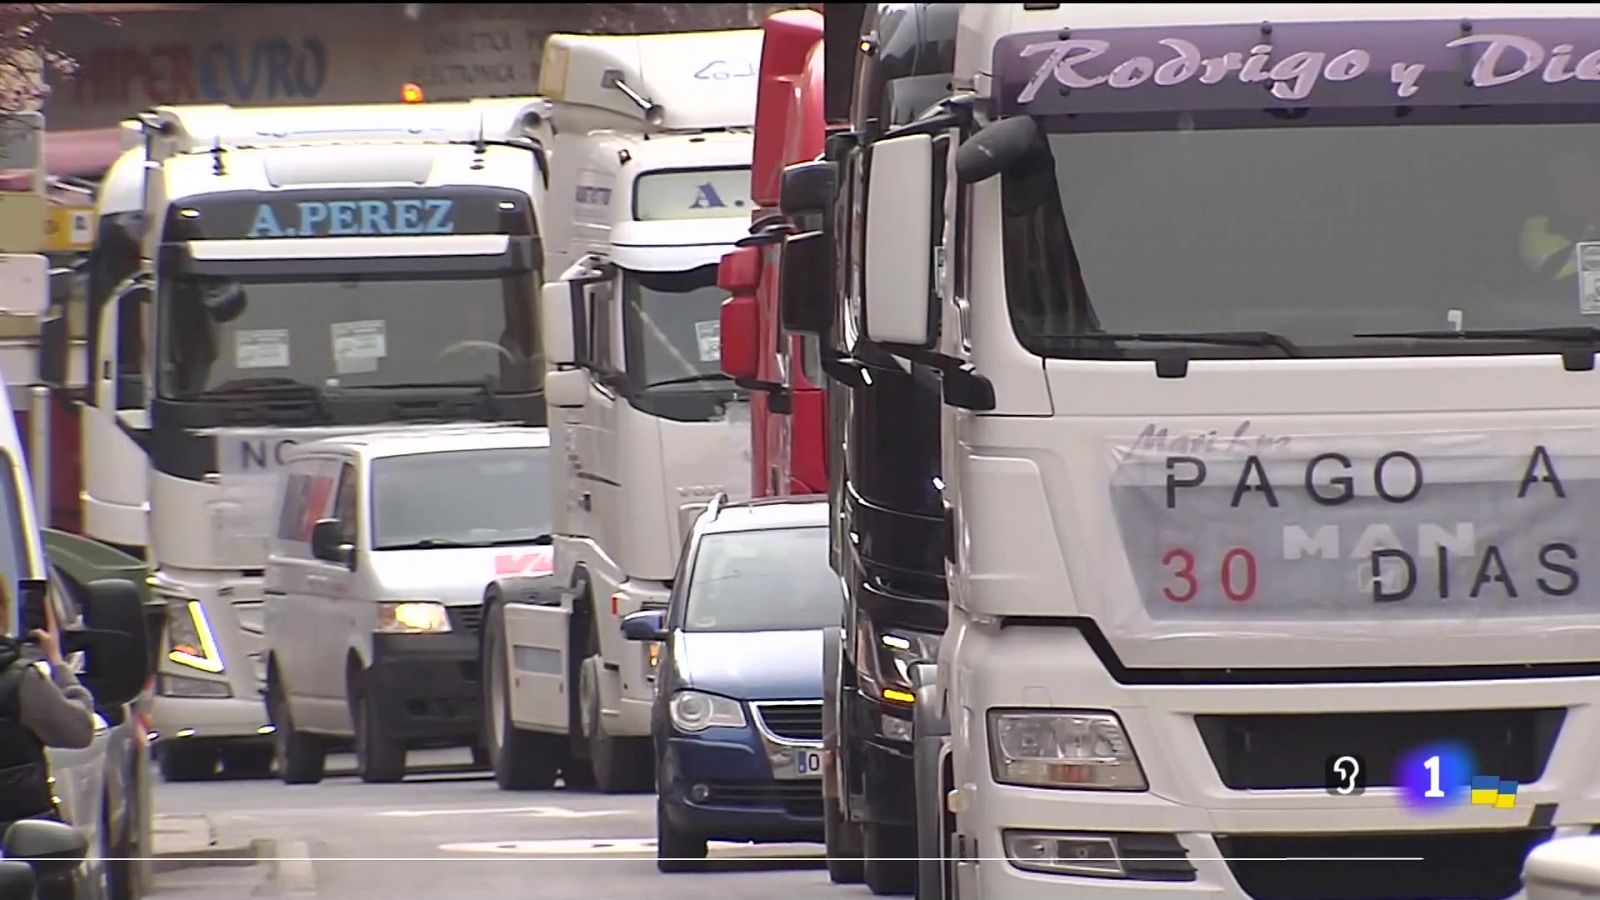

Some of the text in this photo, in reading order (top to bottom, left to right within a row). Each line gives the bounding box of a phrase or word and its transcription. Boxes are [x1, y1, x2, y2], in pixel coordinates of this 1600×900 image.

[1017, 39, 1369, 103] Rodrigo
[1391, 58, 1425, 97] y
[248, 200, 454, 237] A.PEREZ
[1166, 445, 1566, 508] PAGO A
[1283, 522, 1475, 559] MAN
[1162, 542, 1580, 602] 30 DIAS
